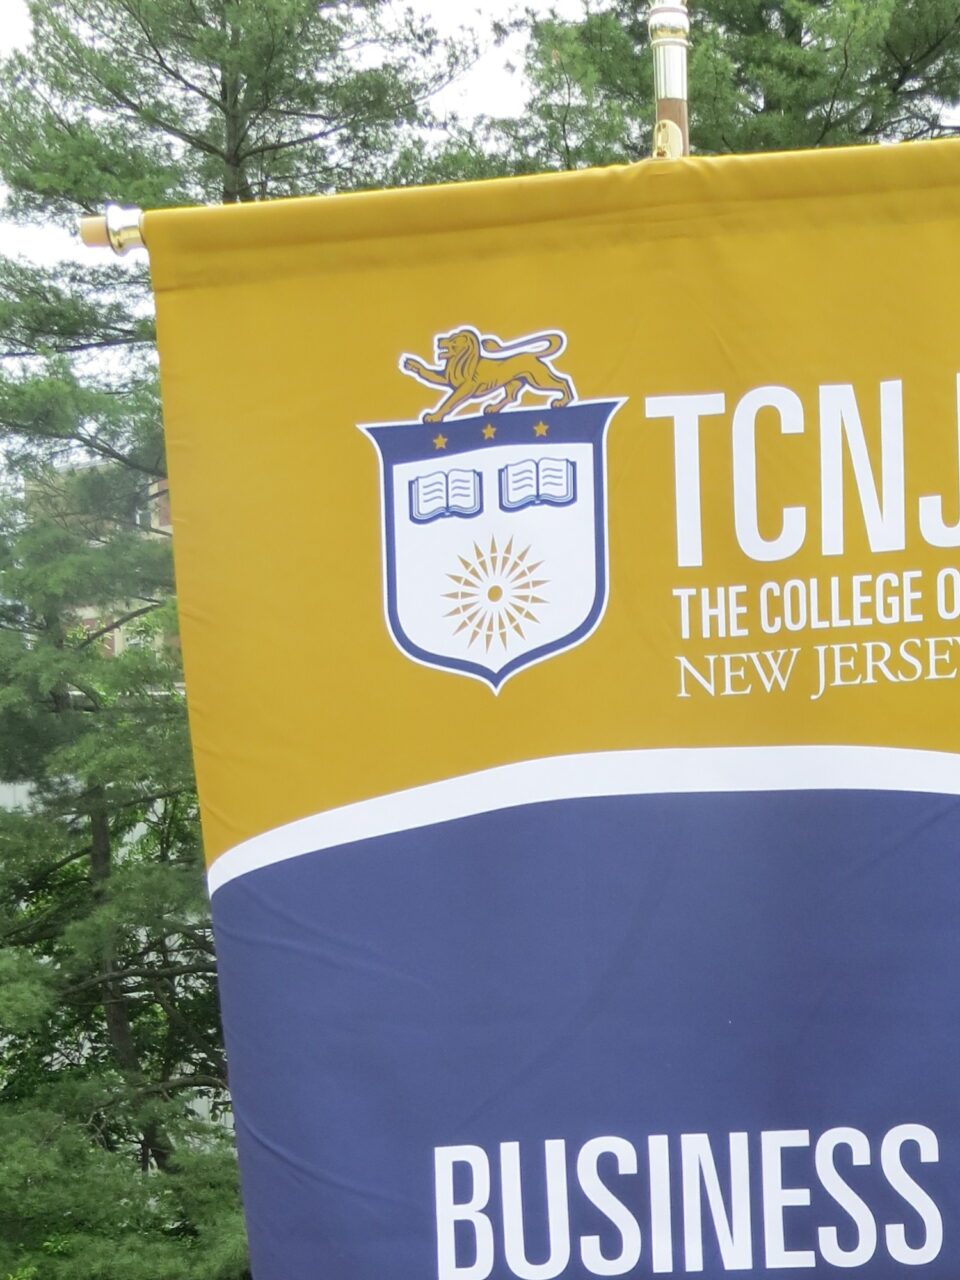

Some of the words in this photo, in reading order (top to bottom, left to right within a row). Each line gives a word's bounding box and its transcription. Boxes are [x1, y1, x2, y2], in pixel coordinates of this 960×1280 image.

[672, 585, 749, 639] THE
[760, 570, 923, 634] COLLEGE
[674, 647, 801, 698] NEW
